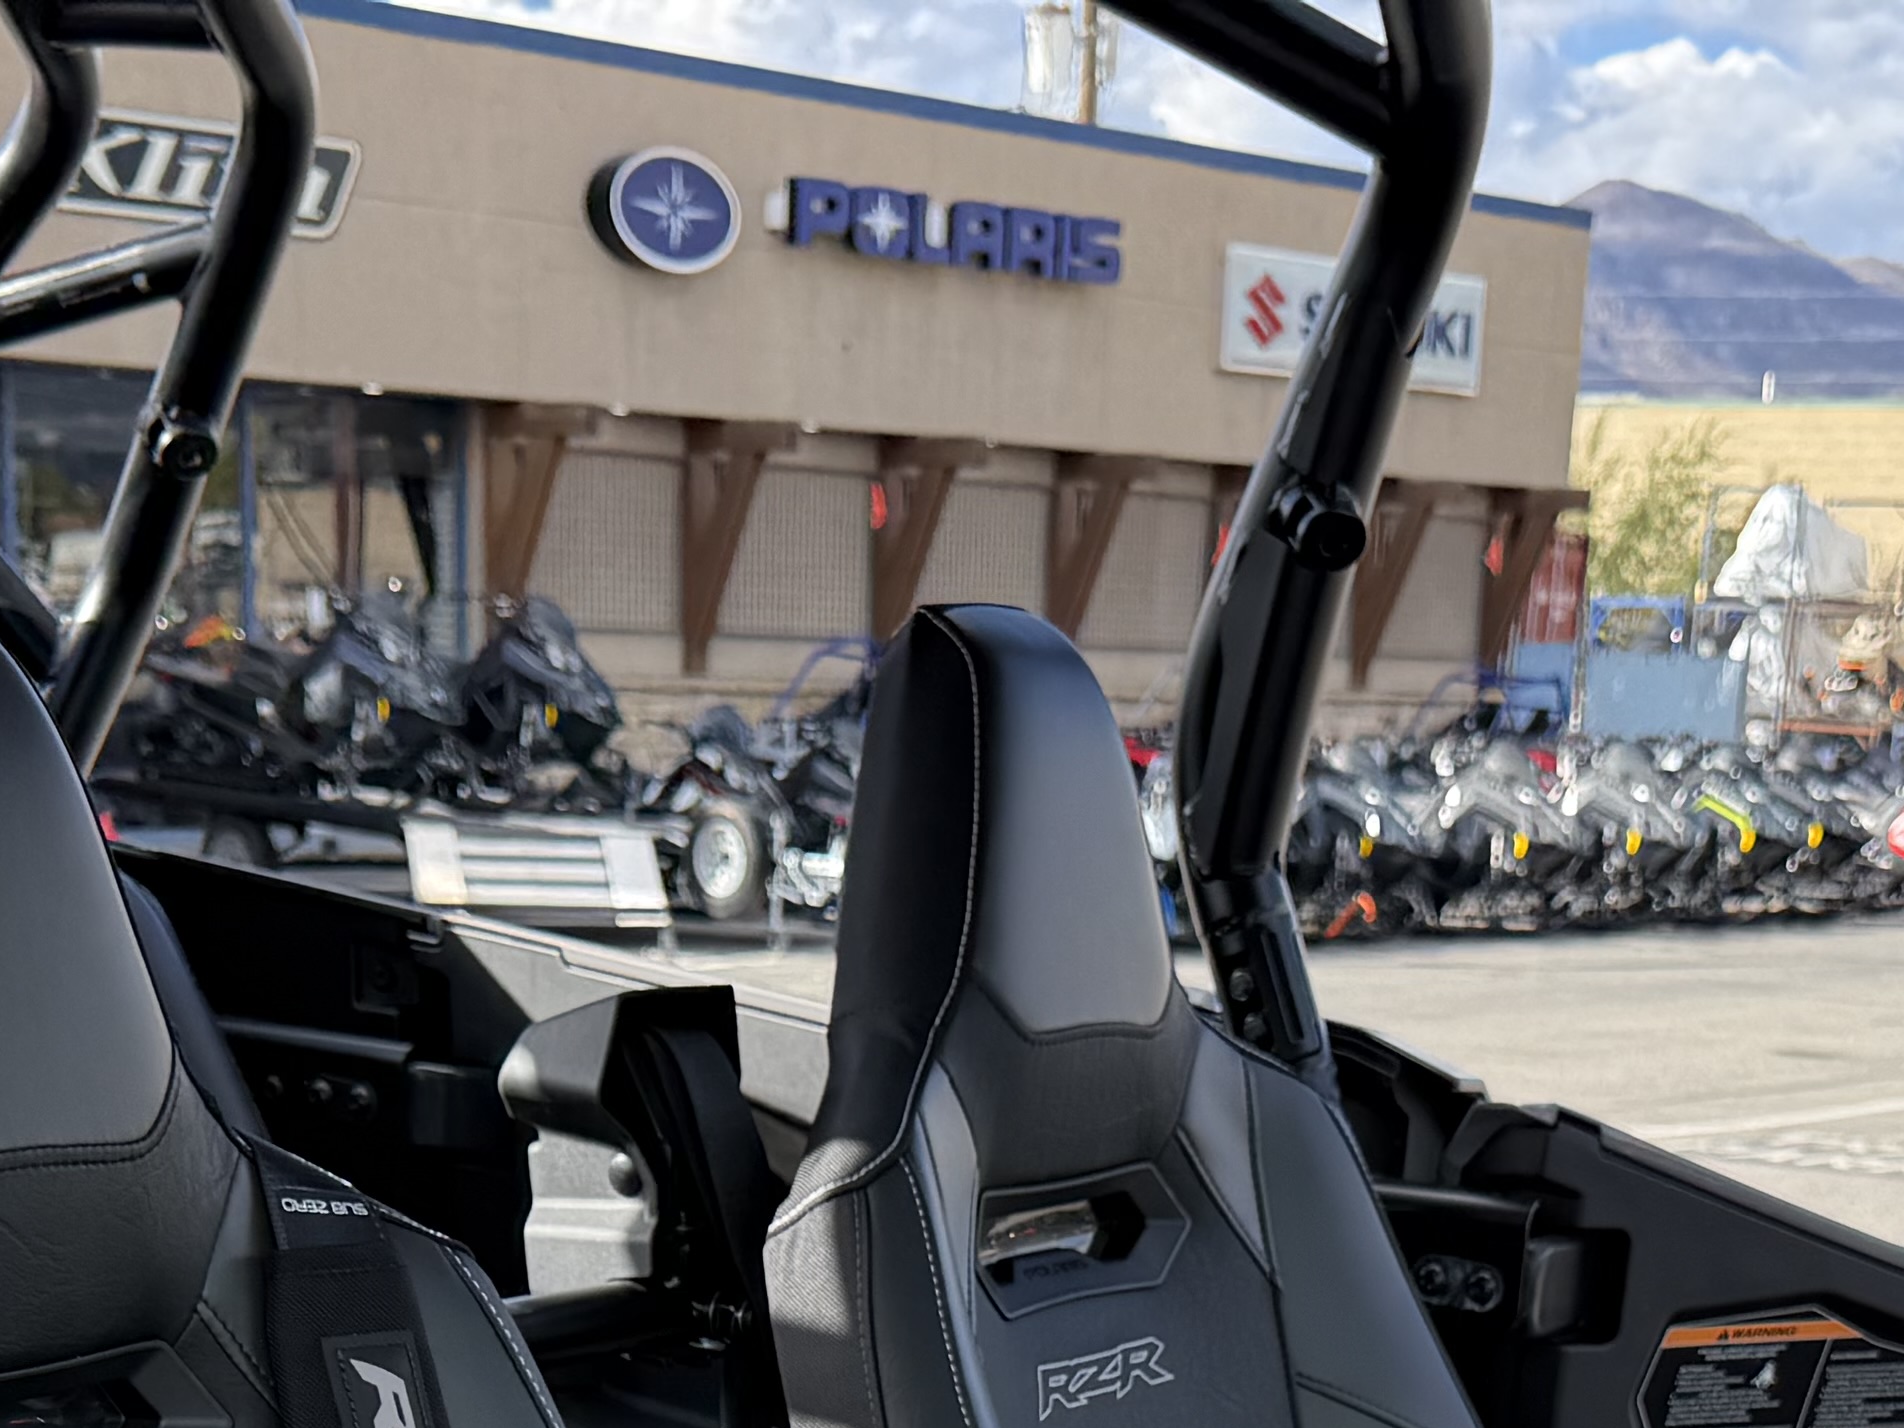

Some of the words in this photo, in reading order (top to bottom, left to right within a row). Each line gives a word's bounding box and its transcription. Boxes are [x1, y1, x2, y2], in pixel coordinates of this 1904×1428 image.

[786, 176, 1123, 286] POLARIS
[330, 1200, 369, 1216] SUB
[1037, 1336, 1175, 1422] RZR
